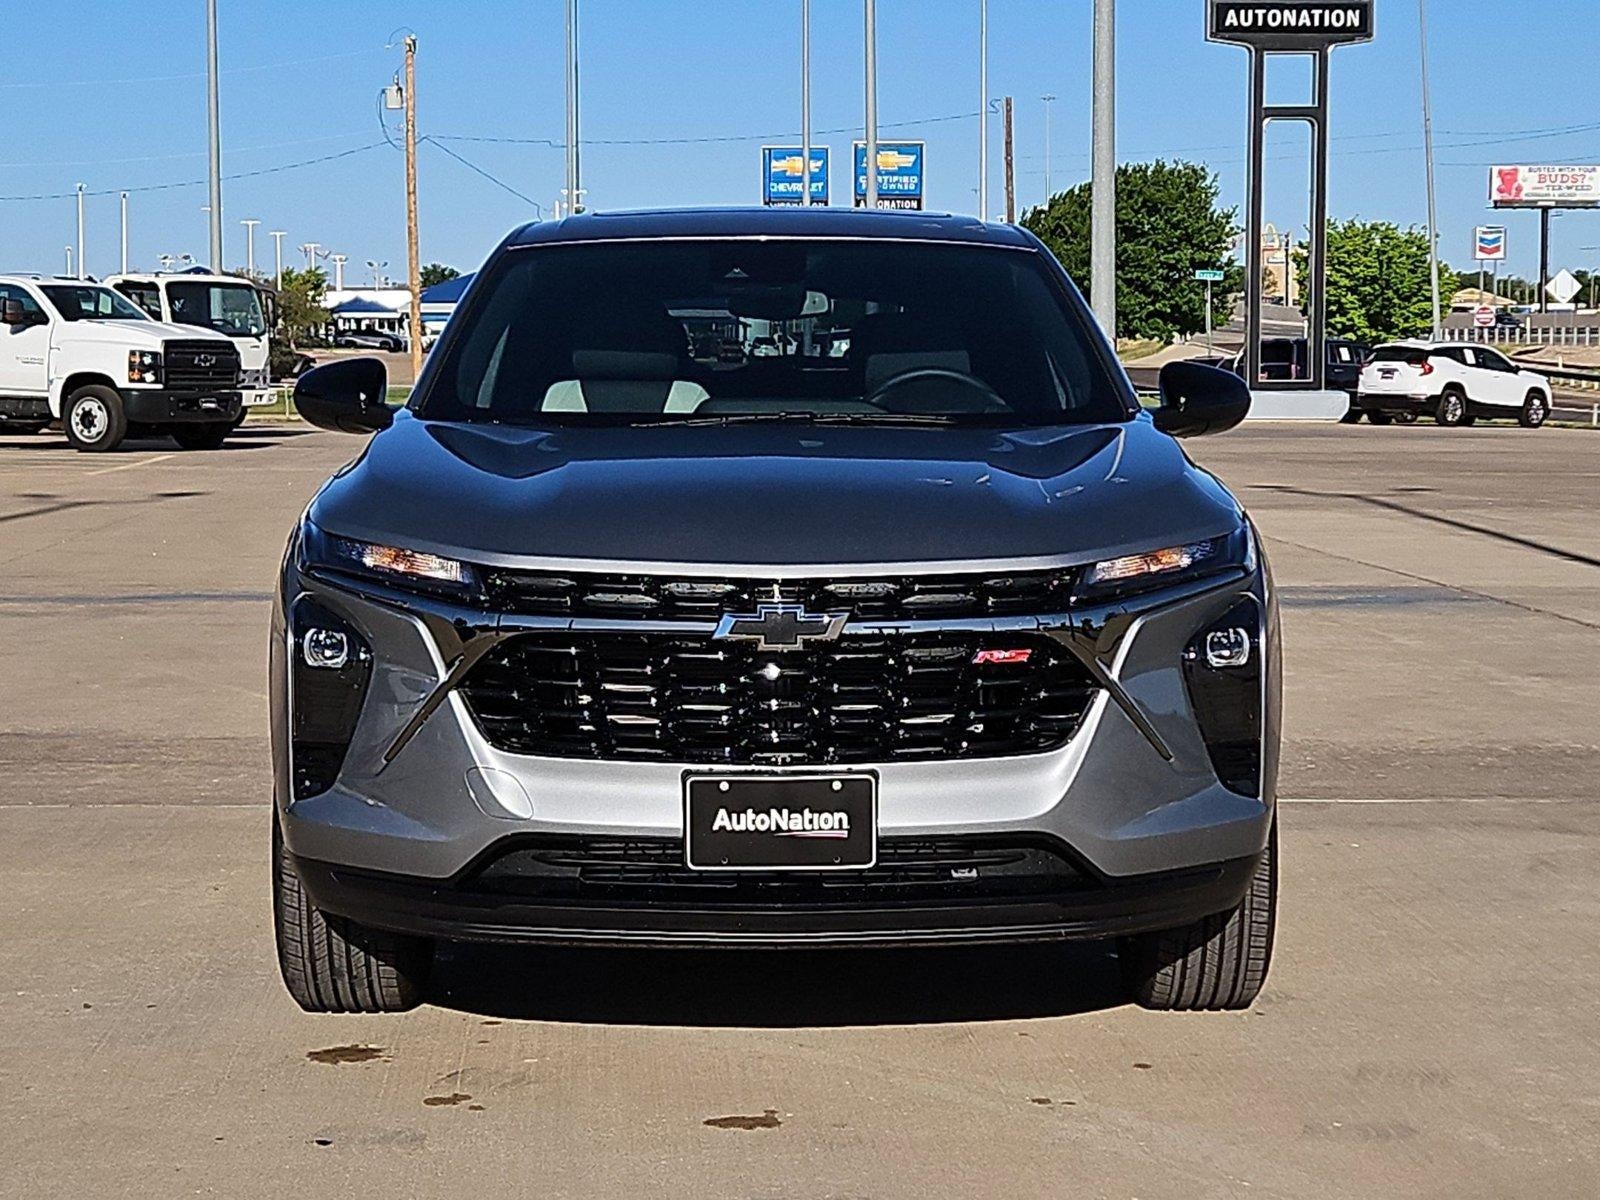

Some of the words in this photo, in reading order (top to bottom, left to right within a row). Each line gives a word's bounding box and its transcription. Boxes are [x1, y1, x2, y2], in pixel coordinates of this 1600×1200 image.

[1225, 9, 1360, 28] AUTONATION
[1537, 173, 1586, 184] BUDS?
[859, 199, 918, 210] AONATION
[712, 808, 850, 832] AutoNation
